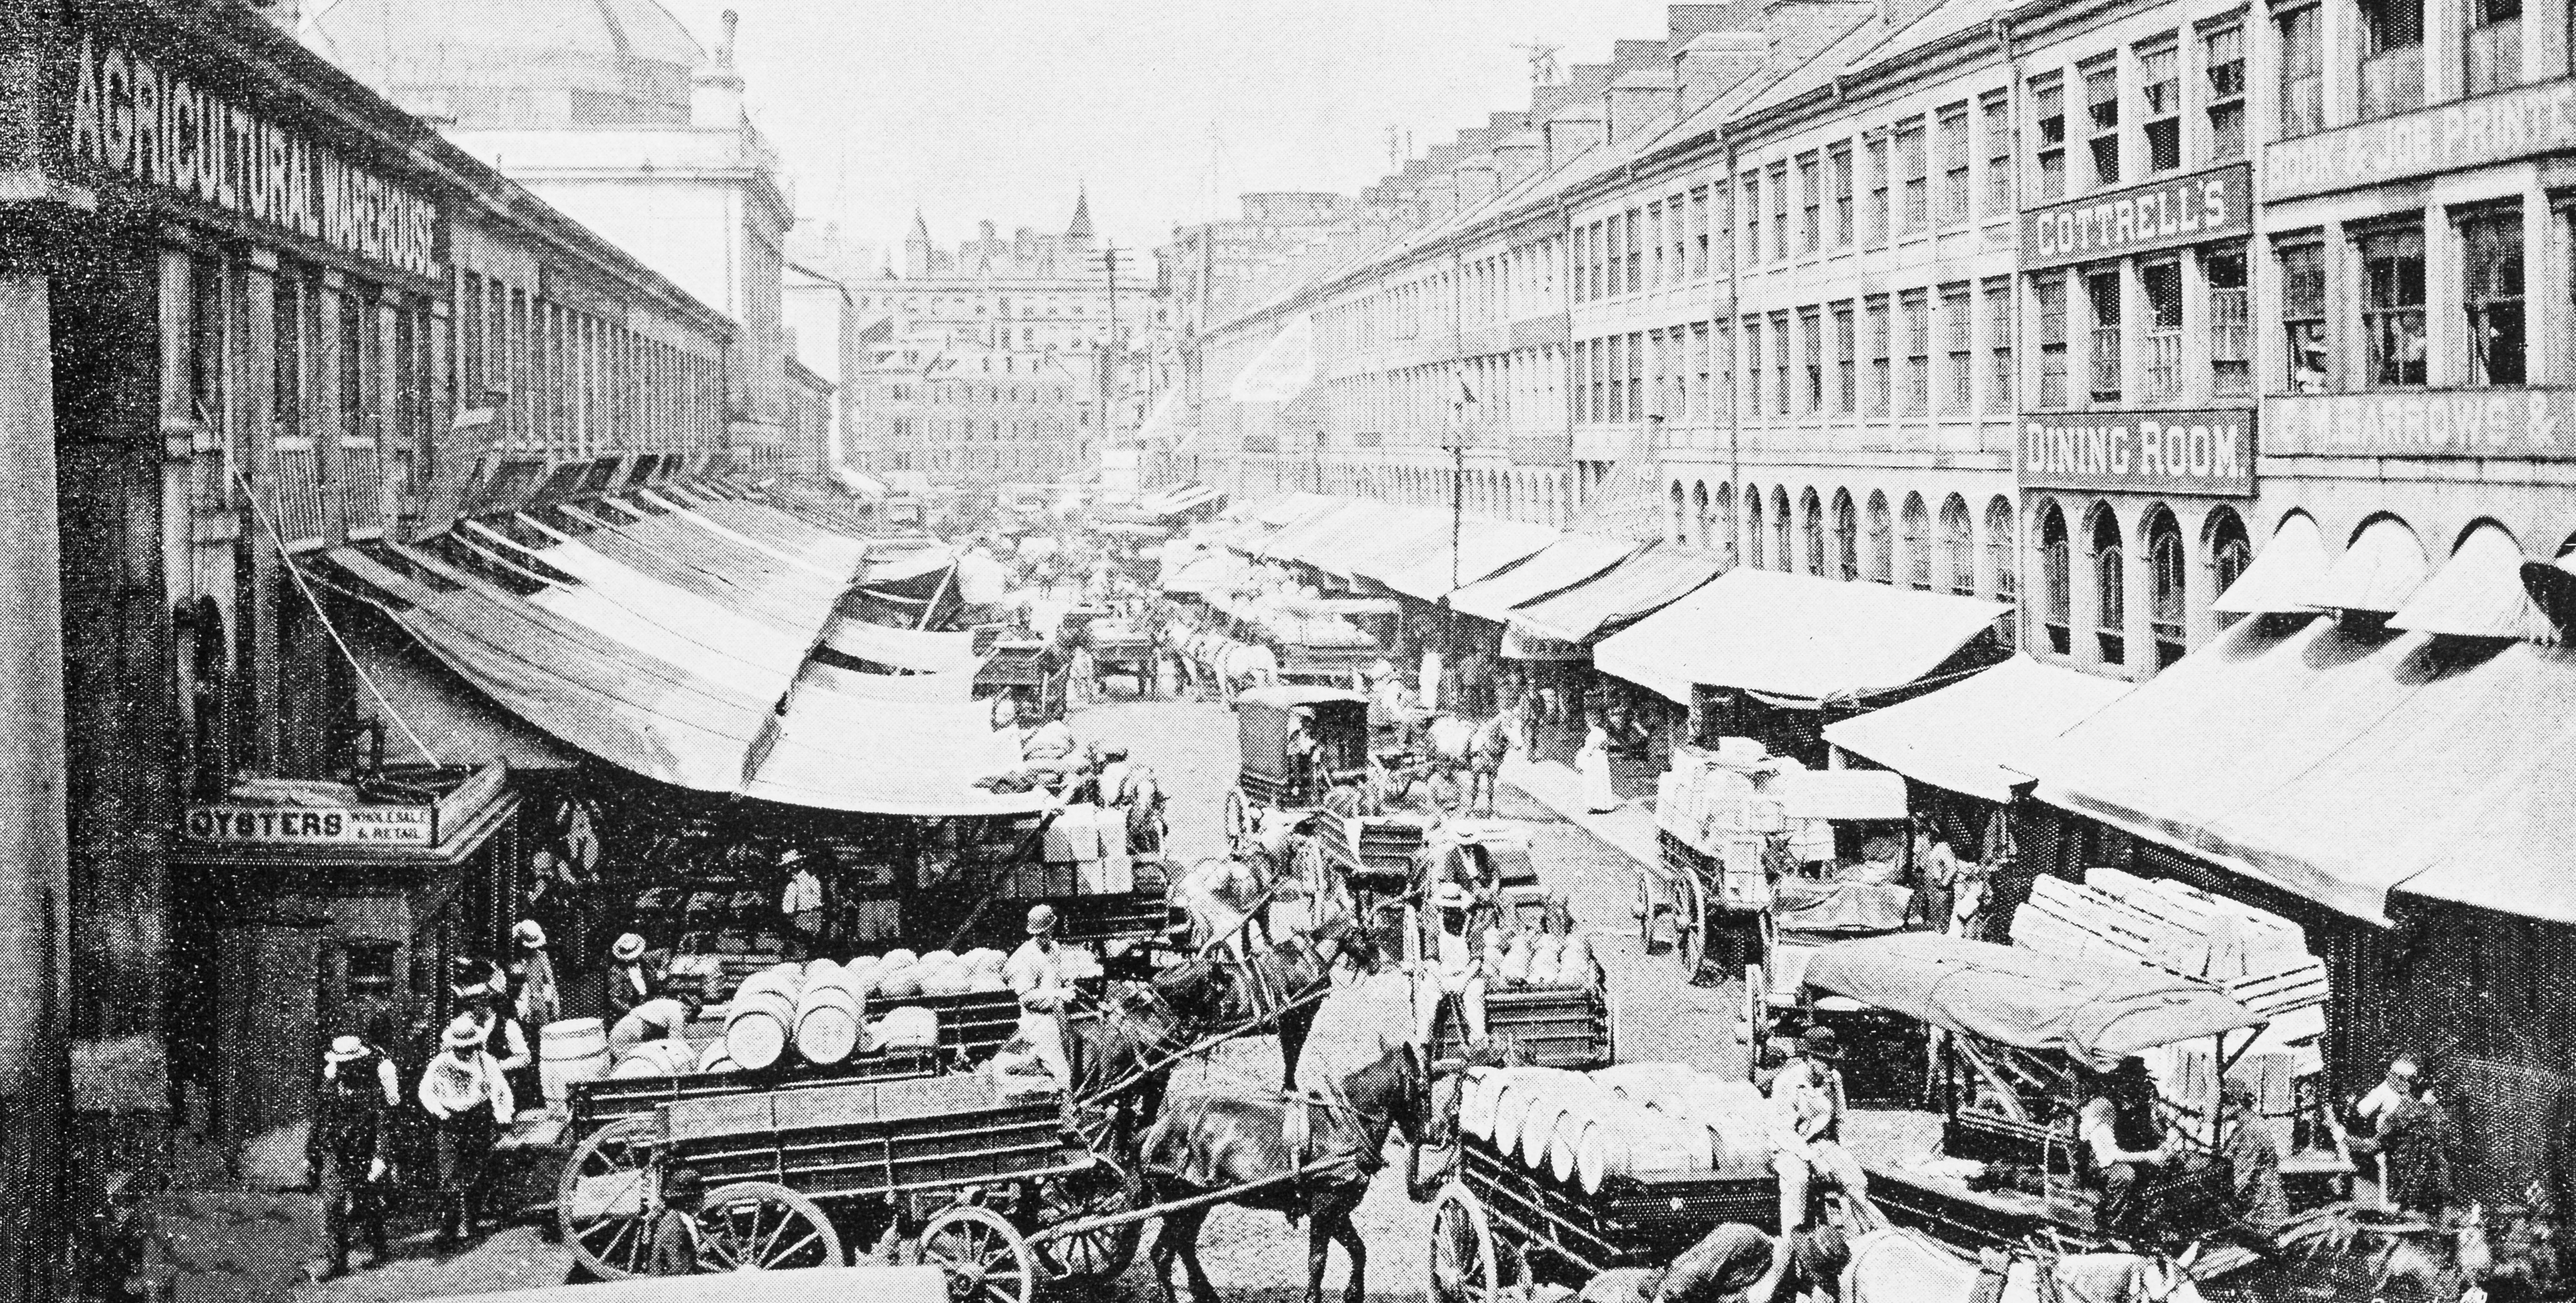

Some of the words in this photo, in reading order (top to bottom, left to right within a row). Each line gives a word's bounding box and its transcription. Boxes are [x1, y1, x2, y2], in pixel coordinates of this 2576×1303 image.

[71, 34, 319, 238] AGRICULTURAL
[321, 147, 441, 279] WAREHOUSE
[2037, 180, 2225, 256] COTTRELL'S
[2526, 392, 2558, 447] &
[2027, 423, 2129, 474] DINING
[2140, 420, 2246, 477] ROOM.
[191, 810, 343, 837] OYSTERS
